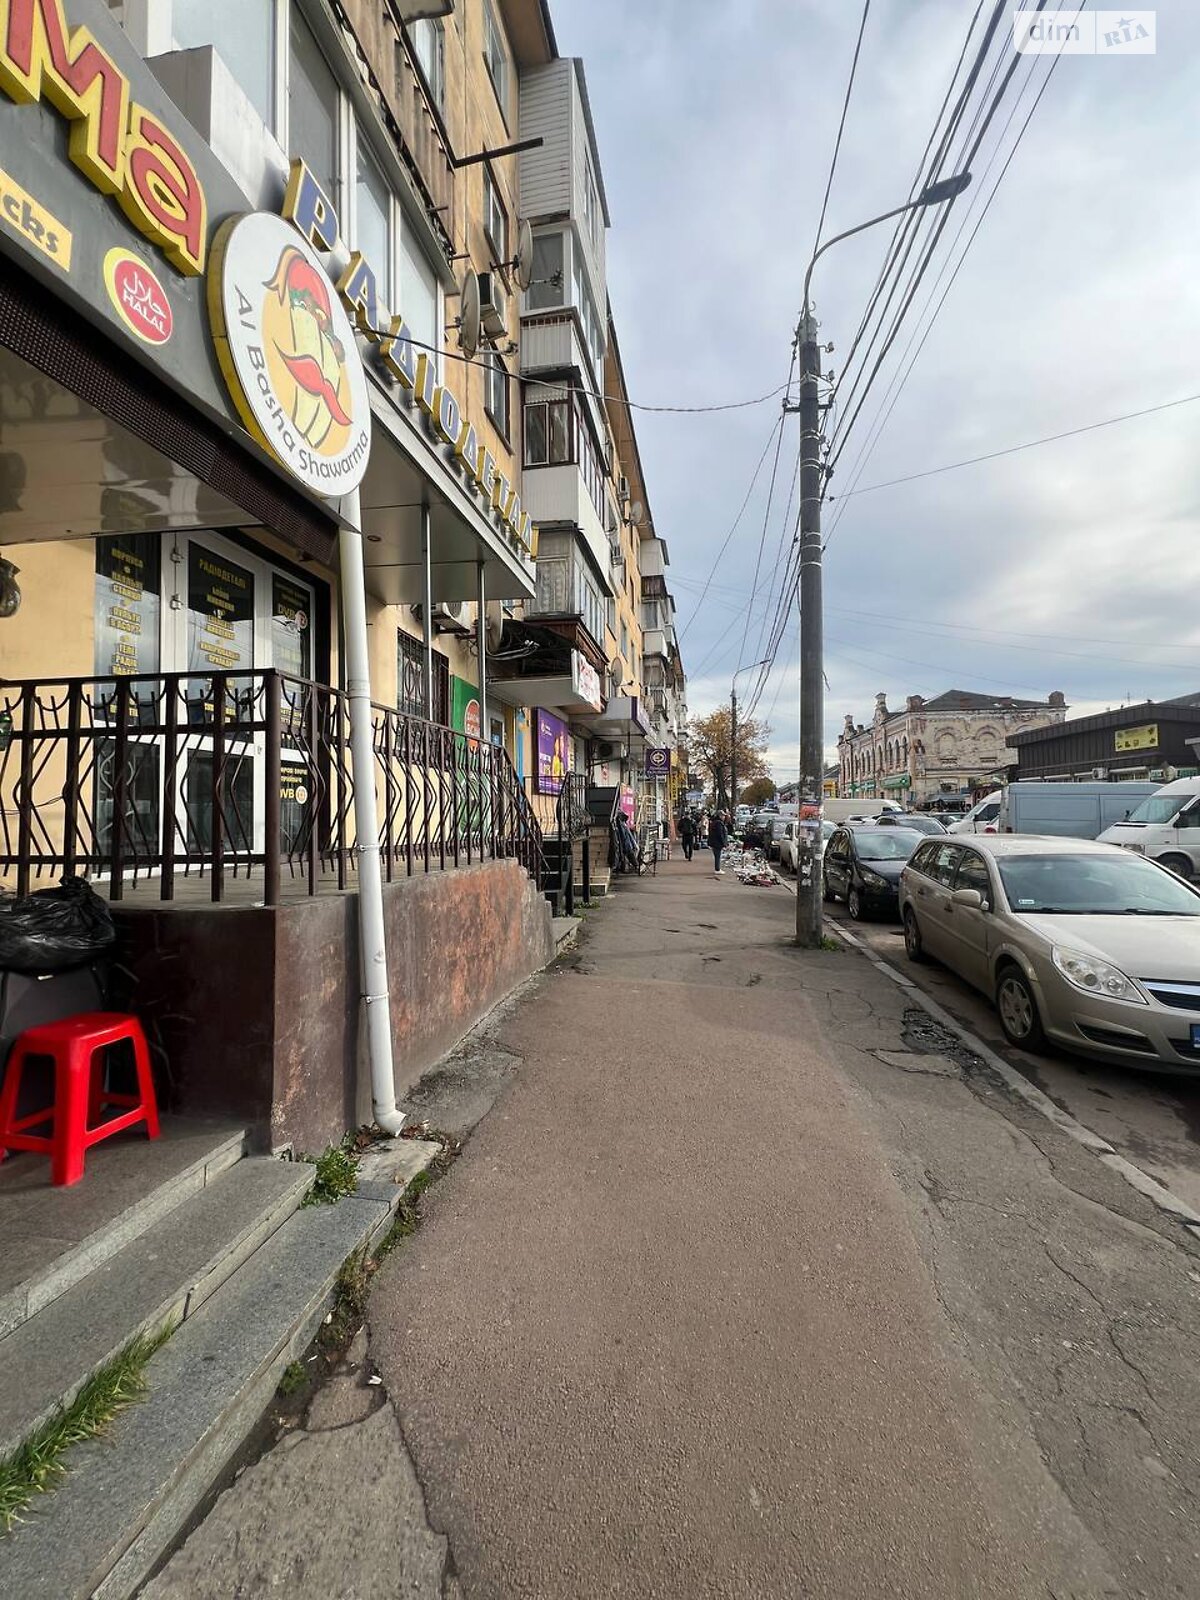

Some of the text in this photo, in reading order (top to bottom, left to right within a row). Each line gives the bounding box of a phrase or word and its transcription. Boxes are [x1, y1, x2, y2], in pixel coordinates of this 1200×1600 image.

[123, 271, 167, 319] حلال
[123, 288, 167, 337] HALAL
[235, 284, 369, 480] Al Basha Shawarma
